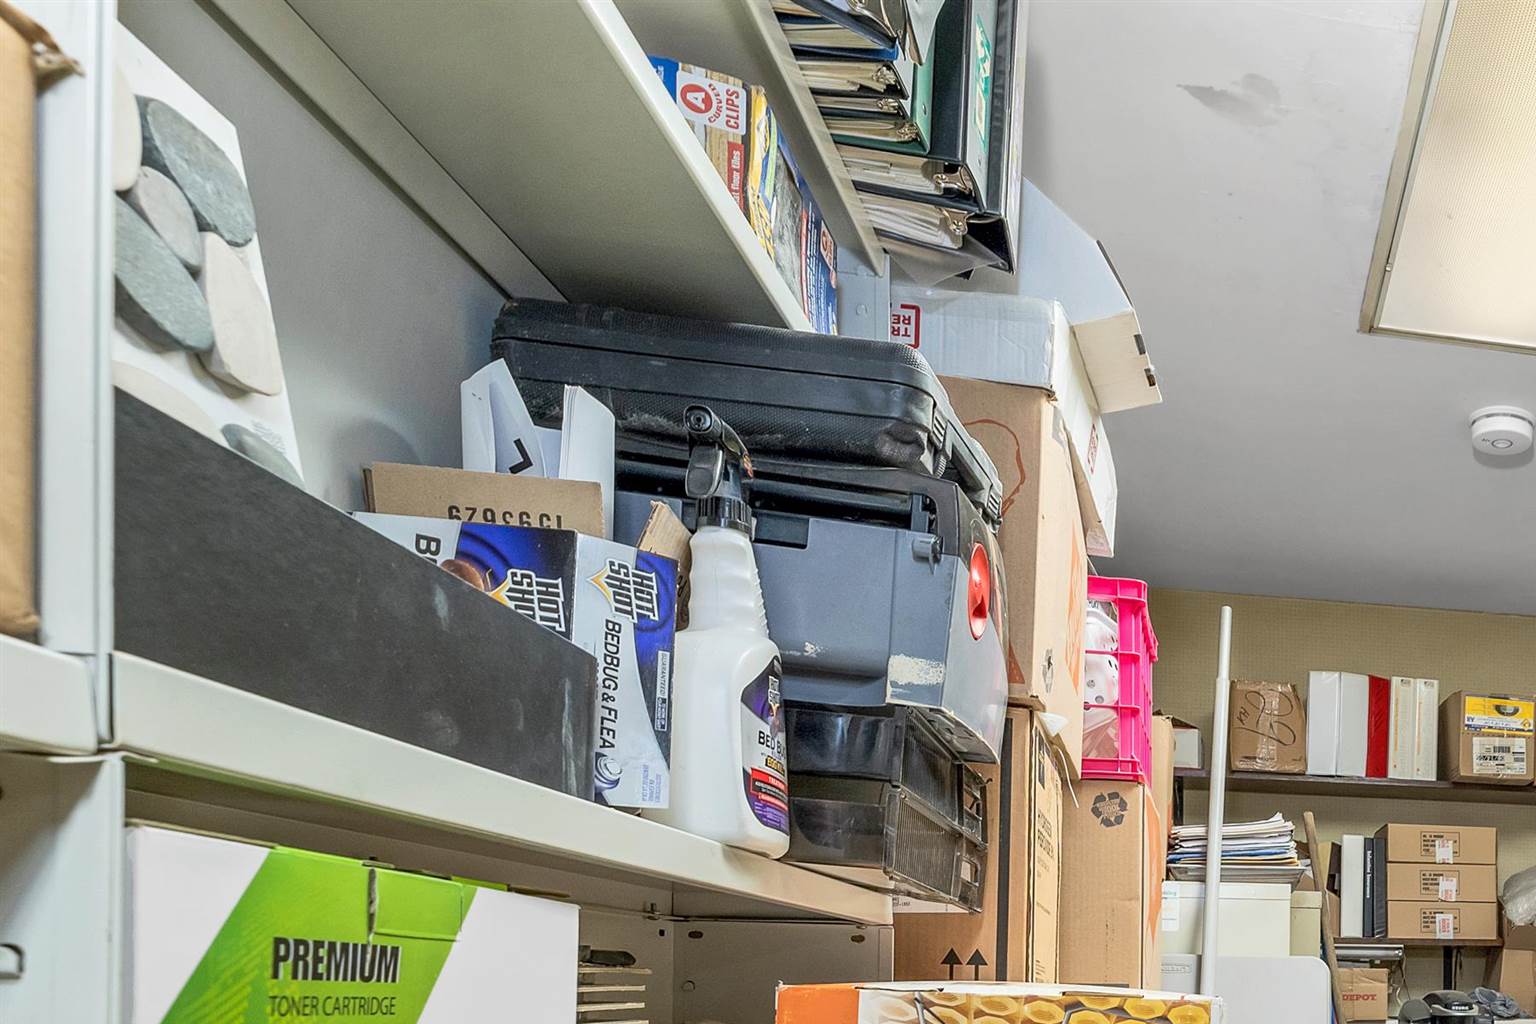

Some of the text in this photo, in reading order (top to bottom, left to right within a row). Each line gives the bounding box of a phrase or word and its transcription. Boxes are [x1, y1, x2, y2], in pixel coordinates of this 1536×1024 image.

[708, 83, 723, 124] CURVED
[725, 88, 740, 129] CLIPS
[511, 571, 536, 620] SHO
[535, 578, 565, 632] HOT
[609, 559, 637, 623] SHOT
[632, 570, 659, 621] HOT
[599, 619, 622, 750] BEDBUG & FLEA
[758, 730, 776, 750] BED
[271, 936, 400, 983] PREMIUM
[268, 995, 397, 1017] TONER CARTRIDGE
